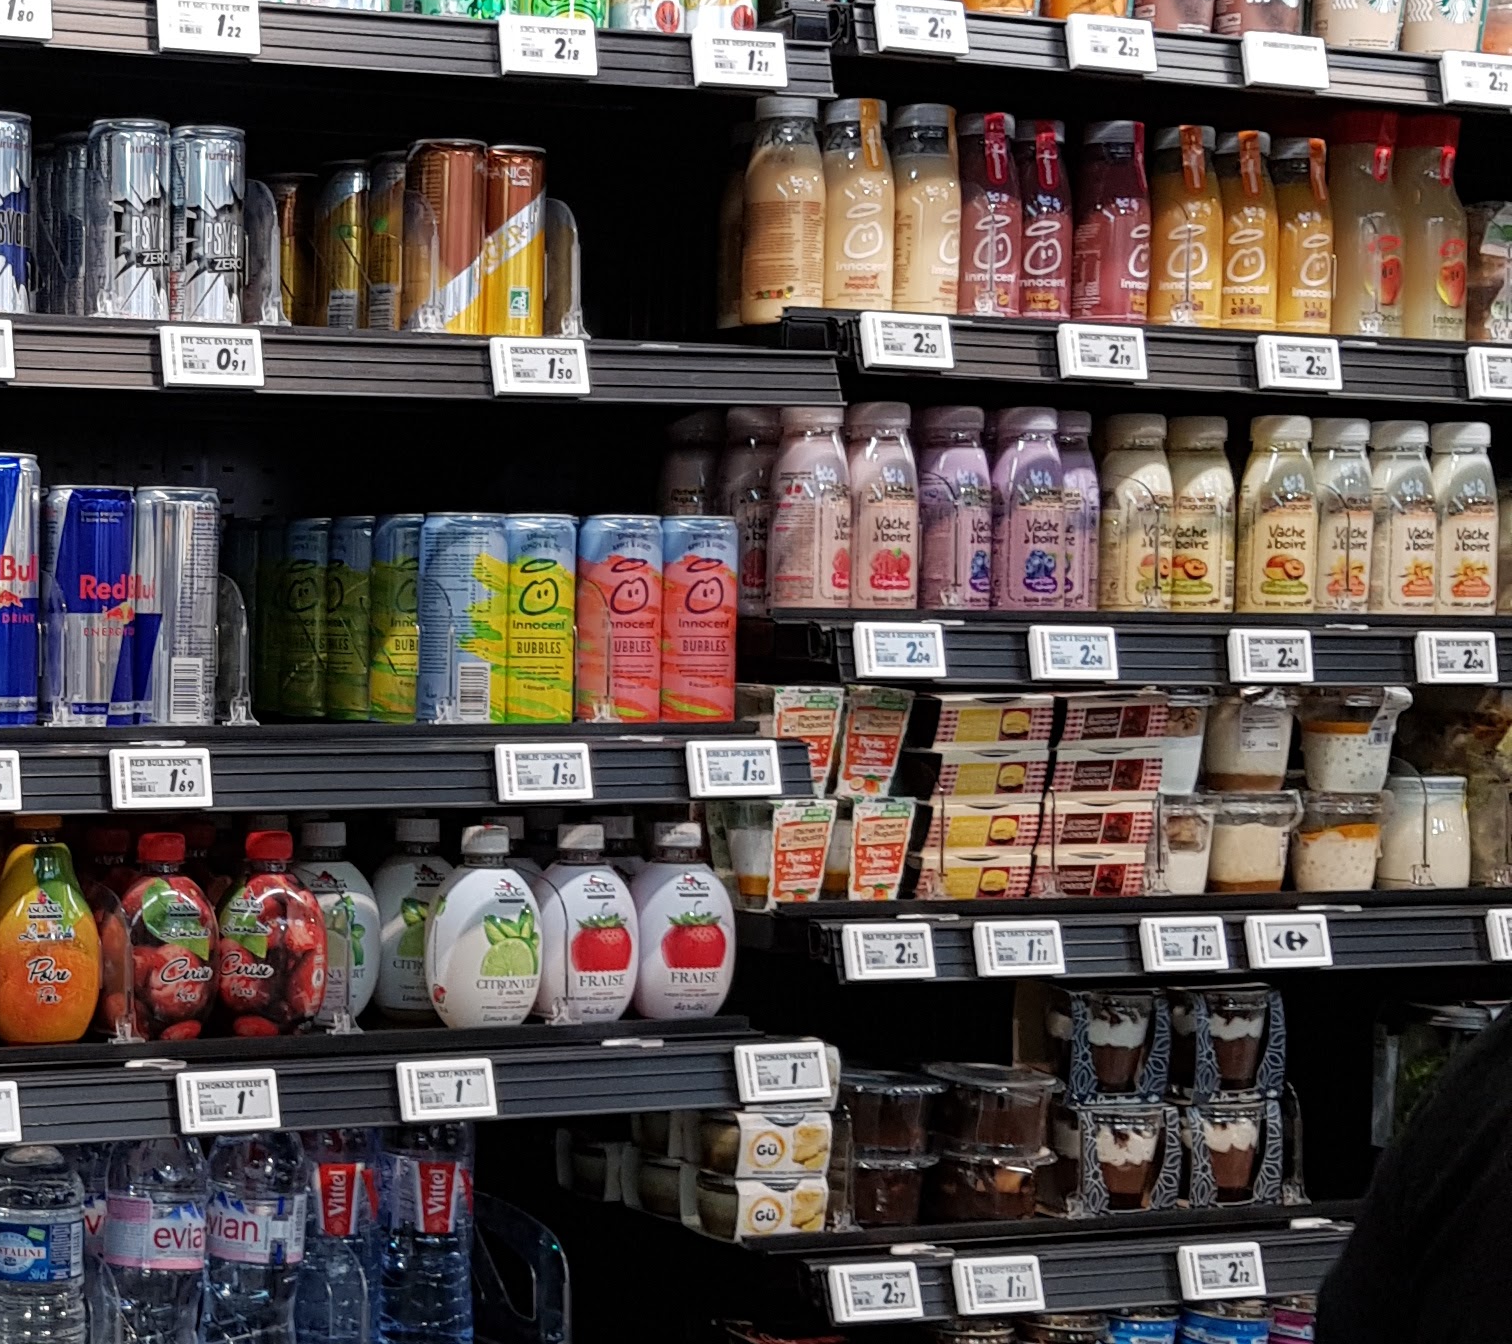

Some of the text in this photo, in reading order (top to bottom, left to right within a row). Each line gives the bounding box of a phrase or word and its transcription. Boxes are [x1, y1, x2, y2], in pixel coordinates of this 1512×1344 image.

[79, 574, 127, 600] Red
[516, 641, 562, 655] BUBBLES
[682, 638, 727, 653] BUBBLES
[26, 956, 72, 986] Poire
[159, 957, 213, 985] Cerise
[220, 952, 274, 979] Cerise
[670, 970, 719, 984] FRAISE
[578, 974, 626, 988] FRAISE
[326, 1169, 348, 1218] Vittel
[425, 1168, 447, 1217] Vittel
